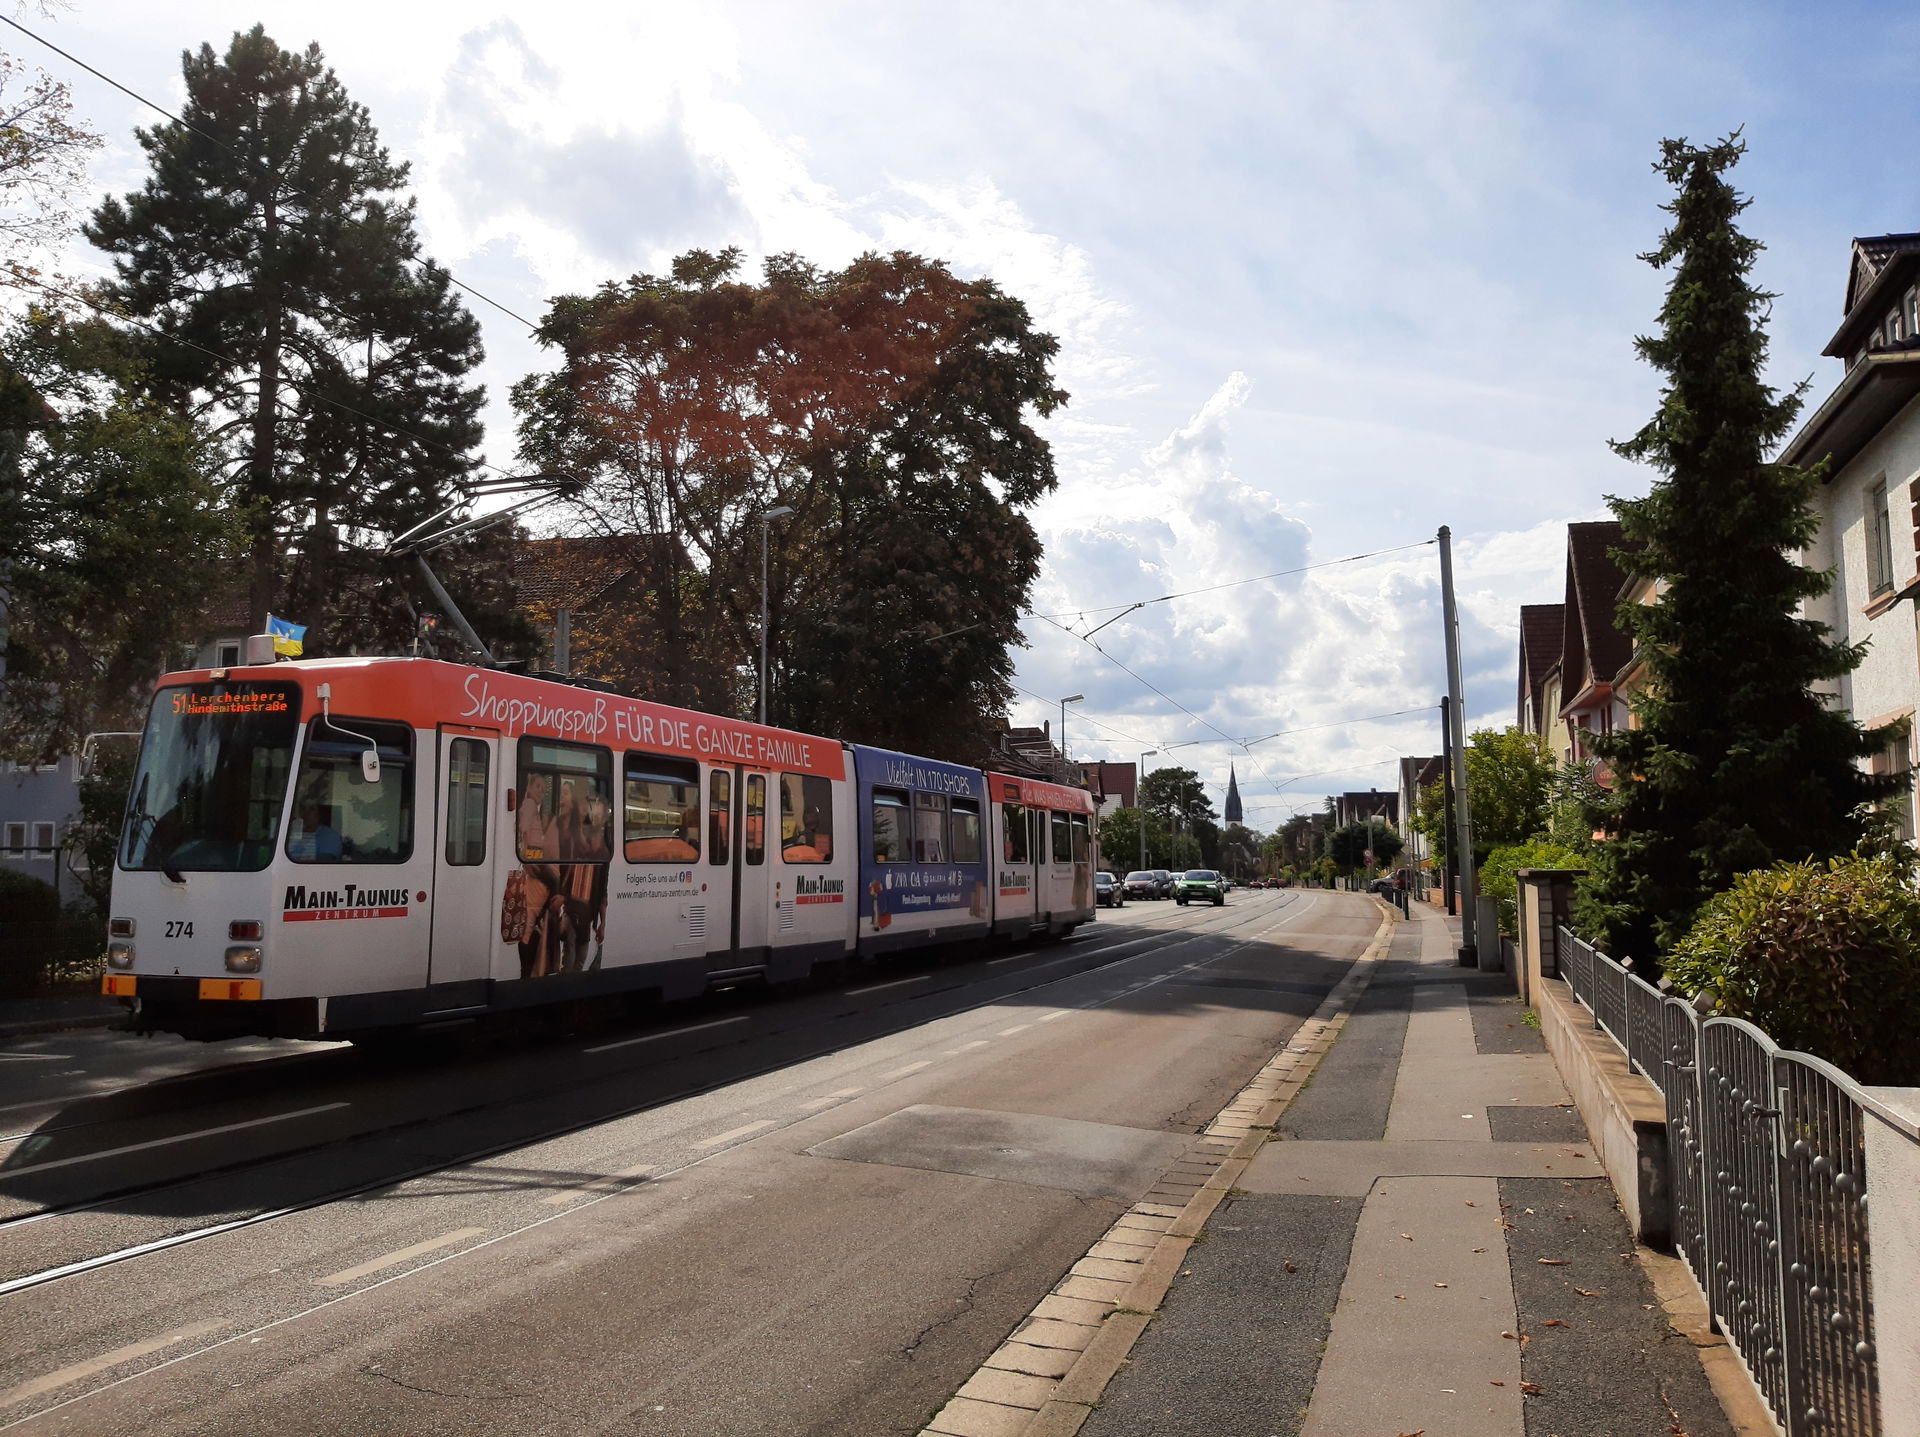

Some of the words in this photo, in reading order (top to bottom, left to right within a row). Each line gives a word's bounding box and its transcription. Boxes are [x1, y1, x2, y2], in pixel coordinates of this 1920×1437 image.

[172, 693, 187, 713] 51
[191, 691, 285, 703] Lerchenberg
[188, 701, 288, 714] Hindemithstraße
[460, 673, 608, 743] Shoppingspaß
[614, 706, 656, 744] FÜR
[659, 718, 692, 750] DIE
[695, 725, 755, 760] GANZE
[757, 736, 812, 768] FAMILIE
[886, 760, 914, 788] Vielfalt
[916, 768, 927, 788] IN
[928, 770, 943, 791] 170
[943, 773, 970, 795] SHOPS
[626, 873, 647, 886] Folgen
[647, 873, 657, 883] Sie
[657, 874, 668, 883] uns
[668, 872, 678, 883] auf
[314, 909, 381, 920] ZENTRUM
[165, 921, 194, 939] 274
